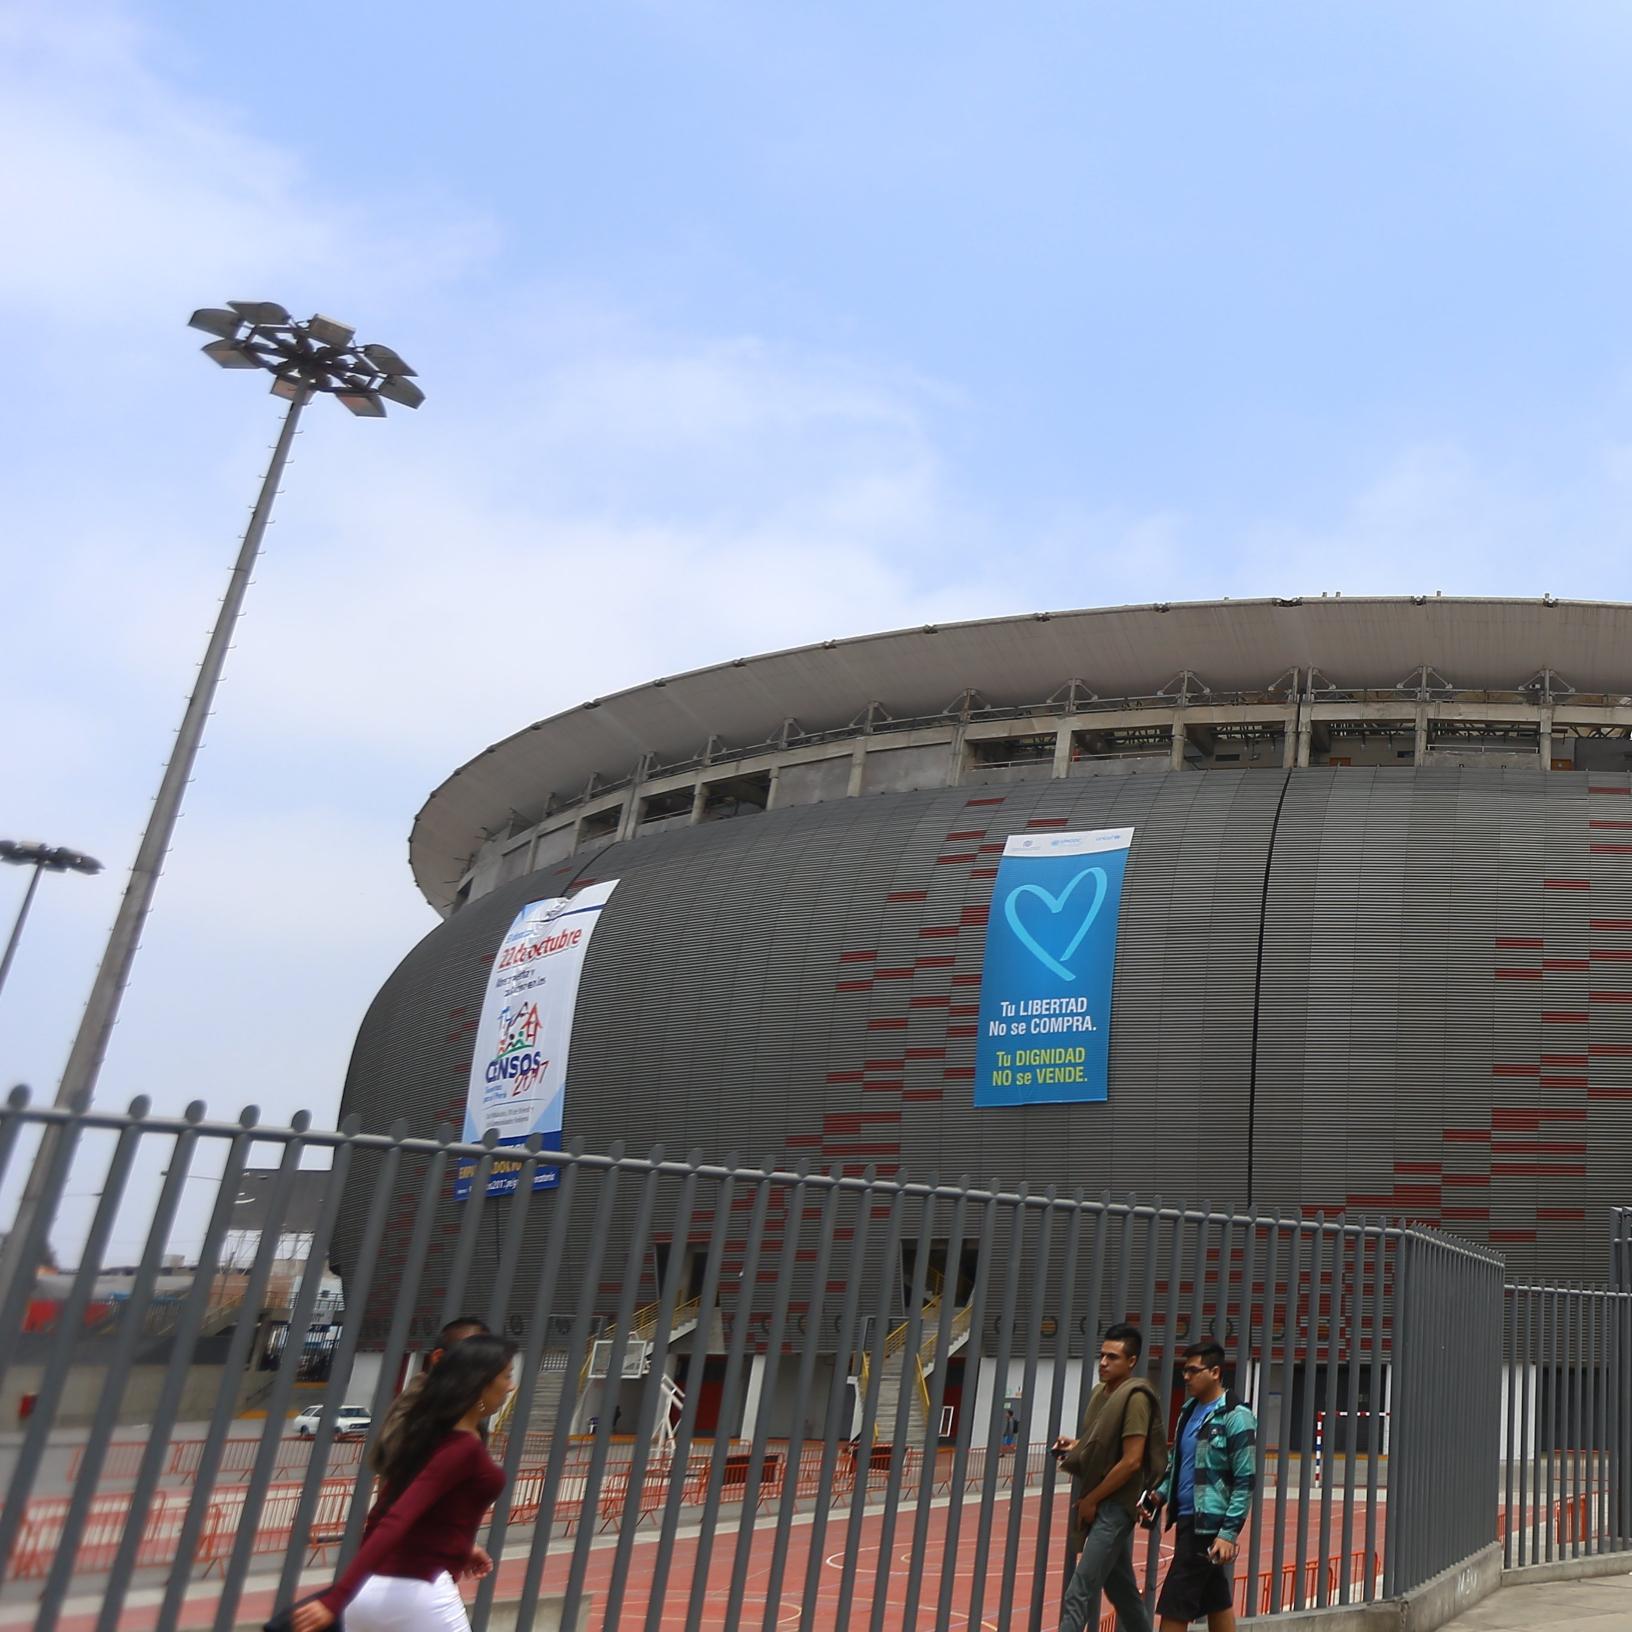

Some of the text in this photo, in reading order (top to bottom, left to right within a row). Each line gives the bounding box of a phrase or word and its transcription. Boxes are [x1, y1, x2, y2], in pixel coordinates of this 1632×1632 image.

[499, 947, 515, 969] 22
[528, 928, 582, 959] octubre
[1000, 997, 1087, 1017] Tu LIBERTAD
[989, 1015, 1097, 1036] No se COMPRA.
[996, 1047, 1085, 1067] Tu DIGNIDAD
[992, 1066, 1088, 1086] NO se VENDE.
